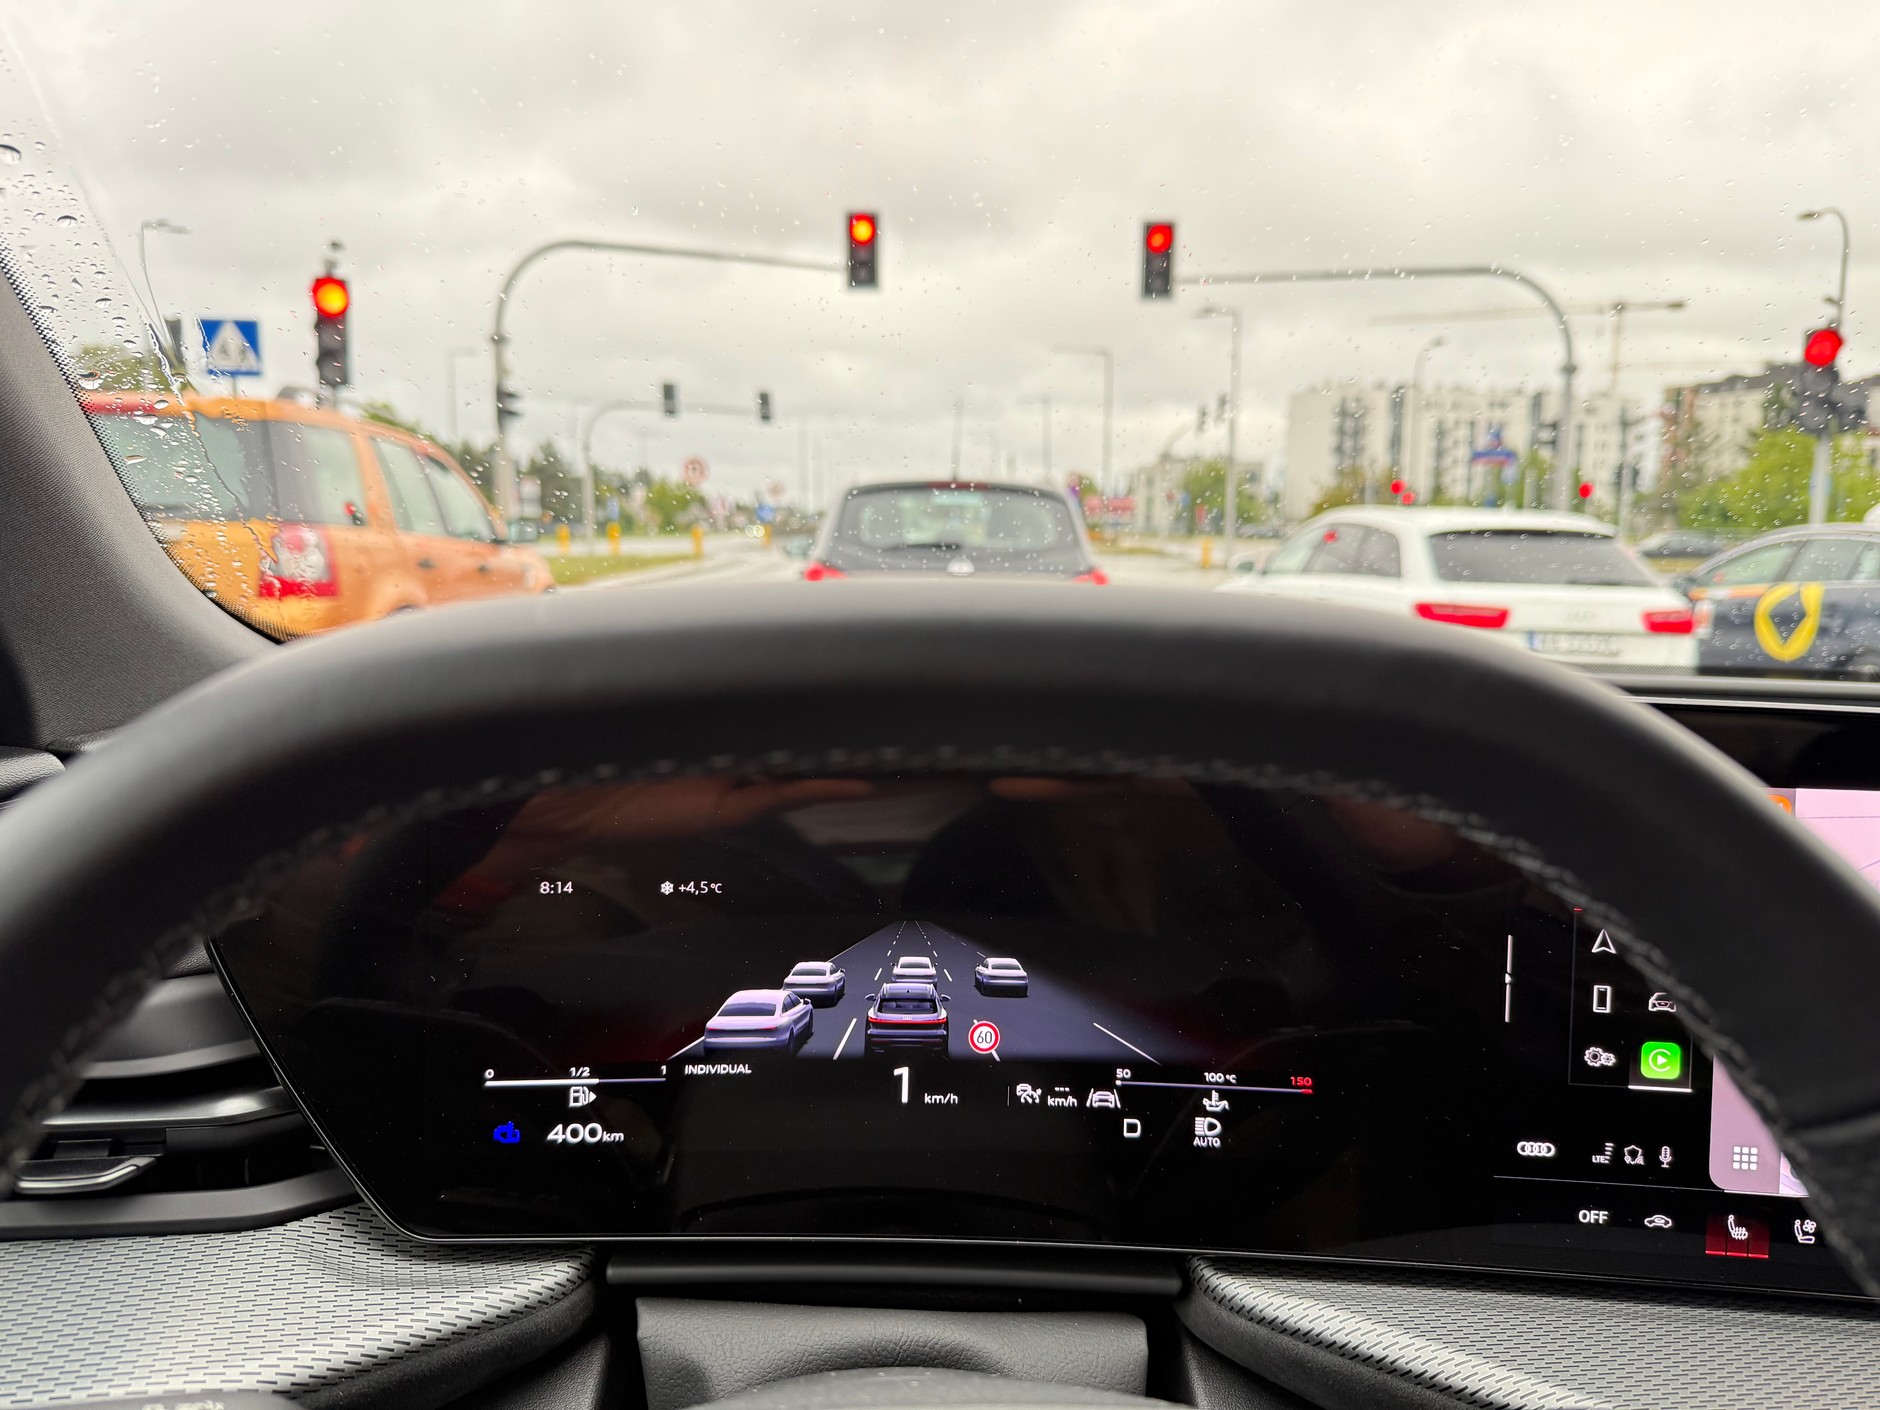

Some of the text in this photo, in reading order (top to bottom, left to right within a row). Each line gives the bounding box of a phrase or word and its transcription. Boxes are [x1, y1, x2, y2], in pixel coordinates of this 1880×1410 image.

[540, 881, 573, 894] 8:14
[976, 1030, 993, 1044] 60
[485, 1069, 494, 1079] 0
[570, 1067, 590, 1077] 1/2
[661, 1065, 666, 1075] 1
[685, 1064, 751, 1074] INDIVIDUAL
[1116, 1069, 1131, 1078] 50
[894, 1067, 958, 1104] 1 km/h
[1291, 1077, 1312, 1086] 150
[1048, 1095, 1077, 1107] km/h
[1124, 1119, 1141, 1137] D
[1193, 1137, 1220, 1147] AUTO
[1592, 1155, 1605, 1163] LTE
[1579, 1210, 1608, 1223] OFF
